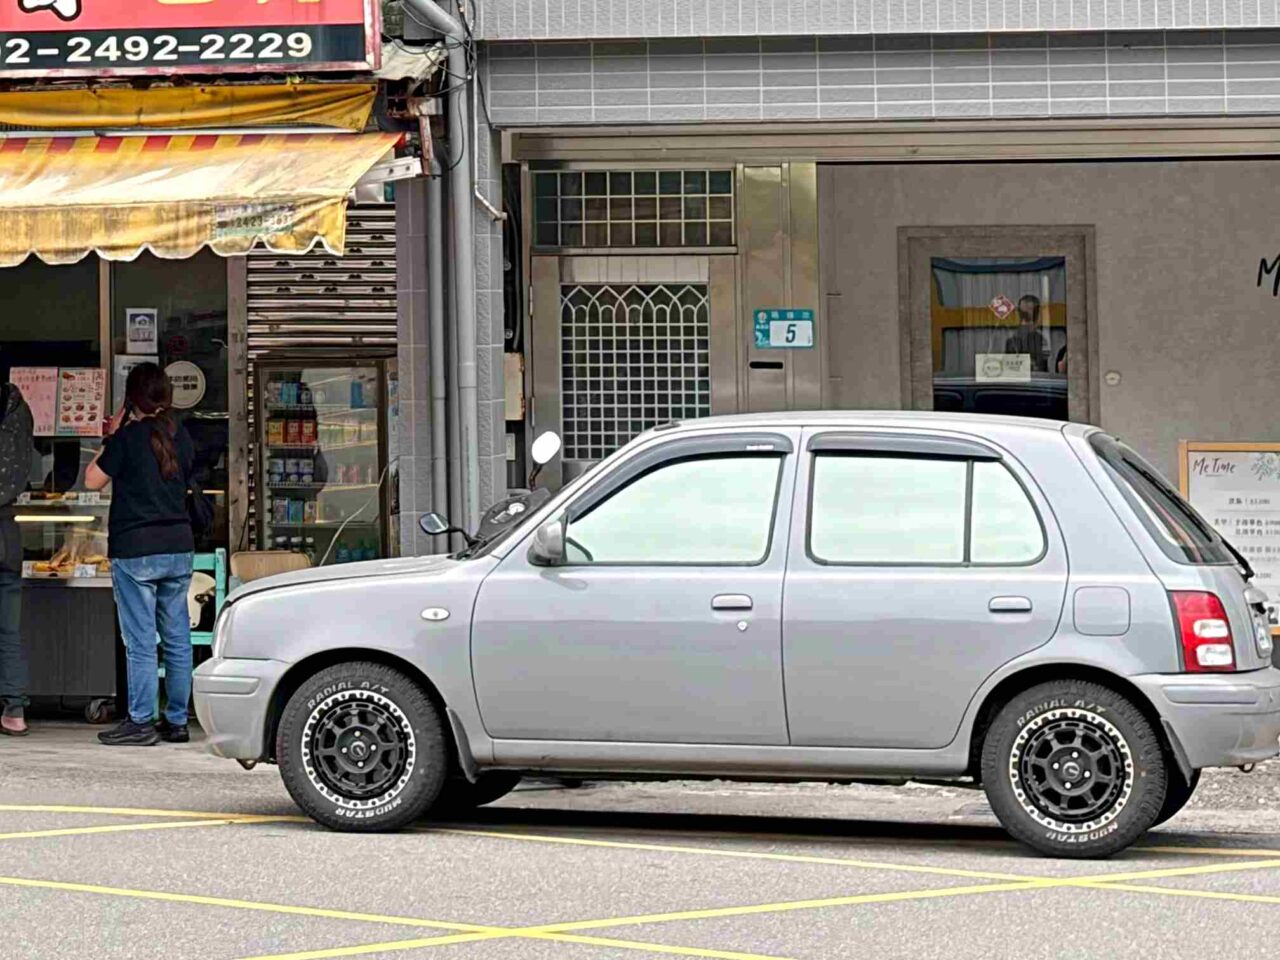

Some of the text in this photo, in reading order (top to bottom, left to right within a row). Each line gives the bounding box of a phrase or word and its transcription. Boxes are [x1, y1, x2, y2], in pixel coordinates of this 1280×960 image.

[785, 323, 797, 343] 5
[307, 681, 355, 710] RADIAL
[1016, 698, 1067, 727] RADIAL
[335, 797, 402, 819] MUDSTAR
